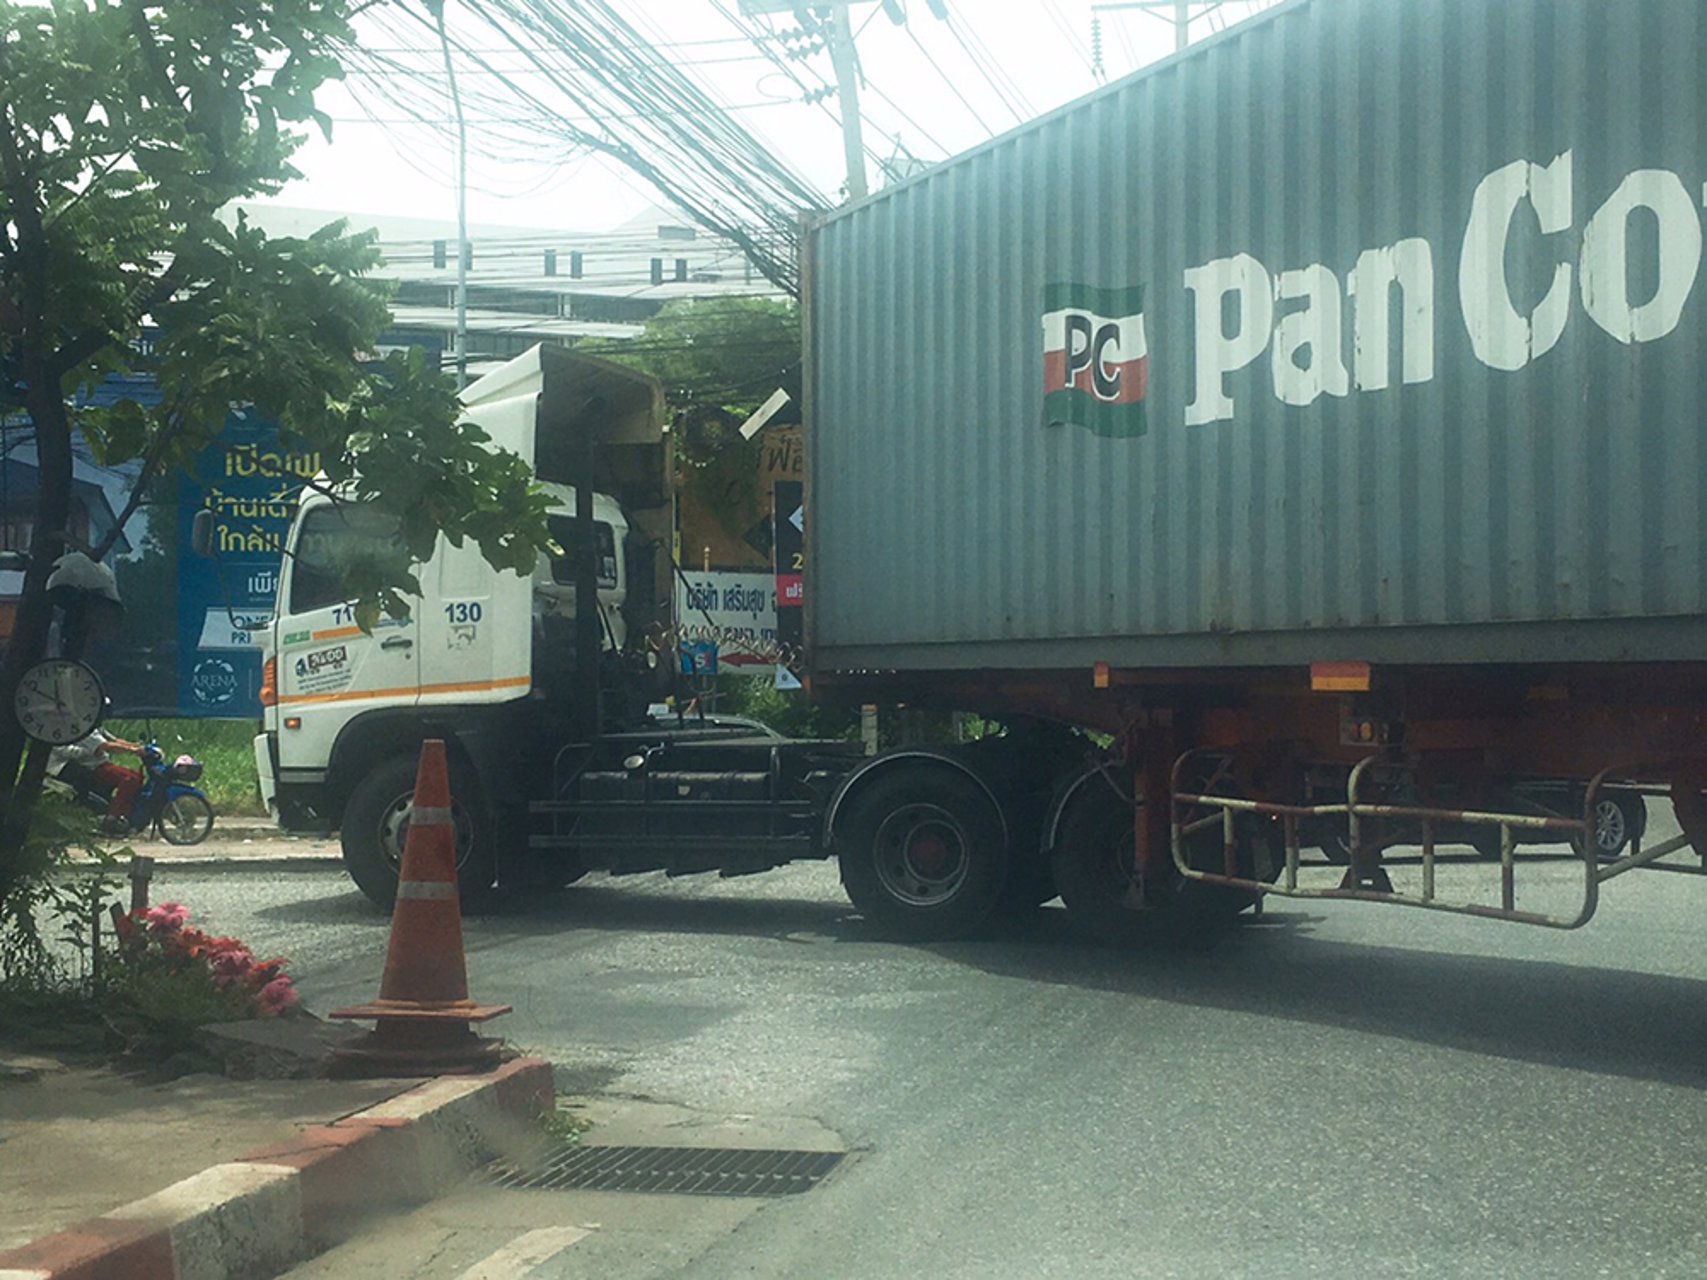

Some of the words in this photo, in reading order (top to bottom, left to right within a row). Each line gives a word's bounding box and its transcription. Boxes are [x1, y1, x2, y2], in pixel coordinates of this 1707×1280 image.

[1459, 148, 1707, 372] Co
[1065, 314, 1121, 401] PC
[445, 602, 482, 623] 130
[190, 674, 238, 690] ARENA
